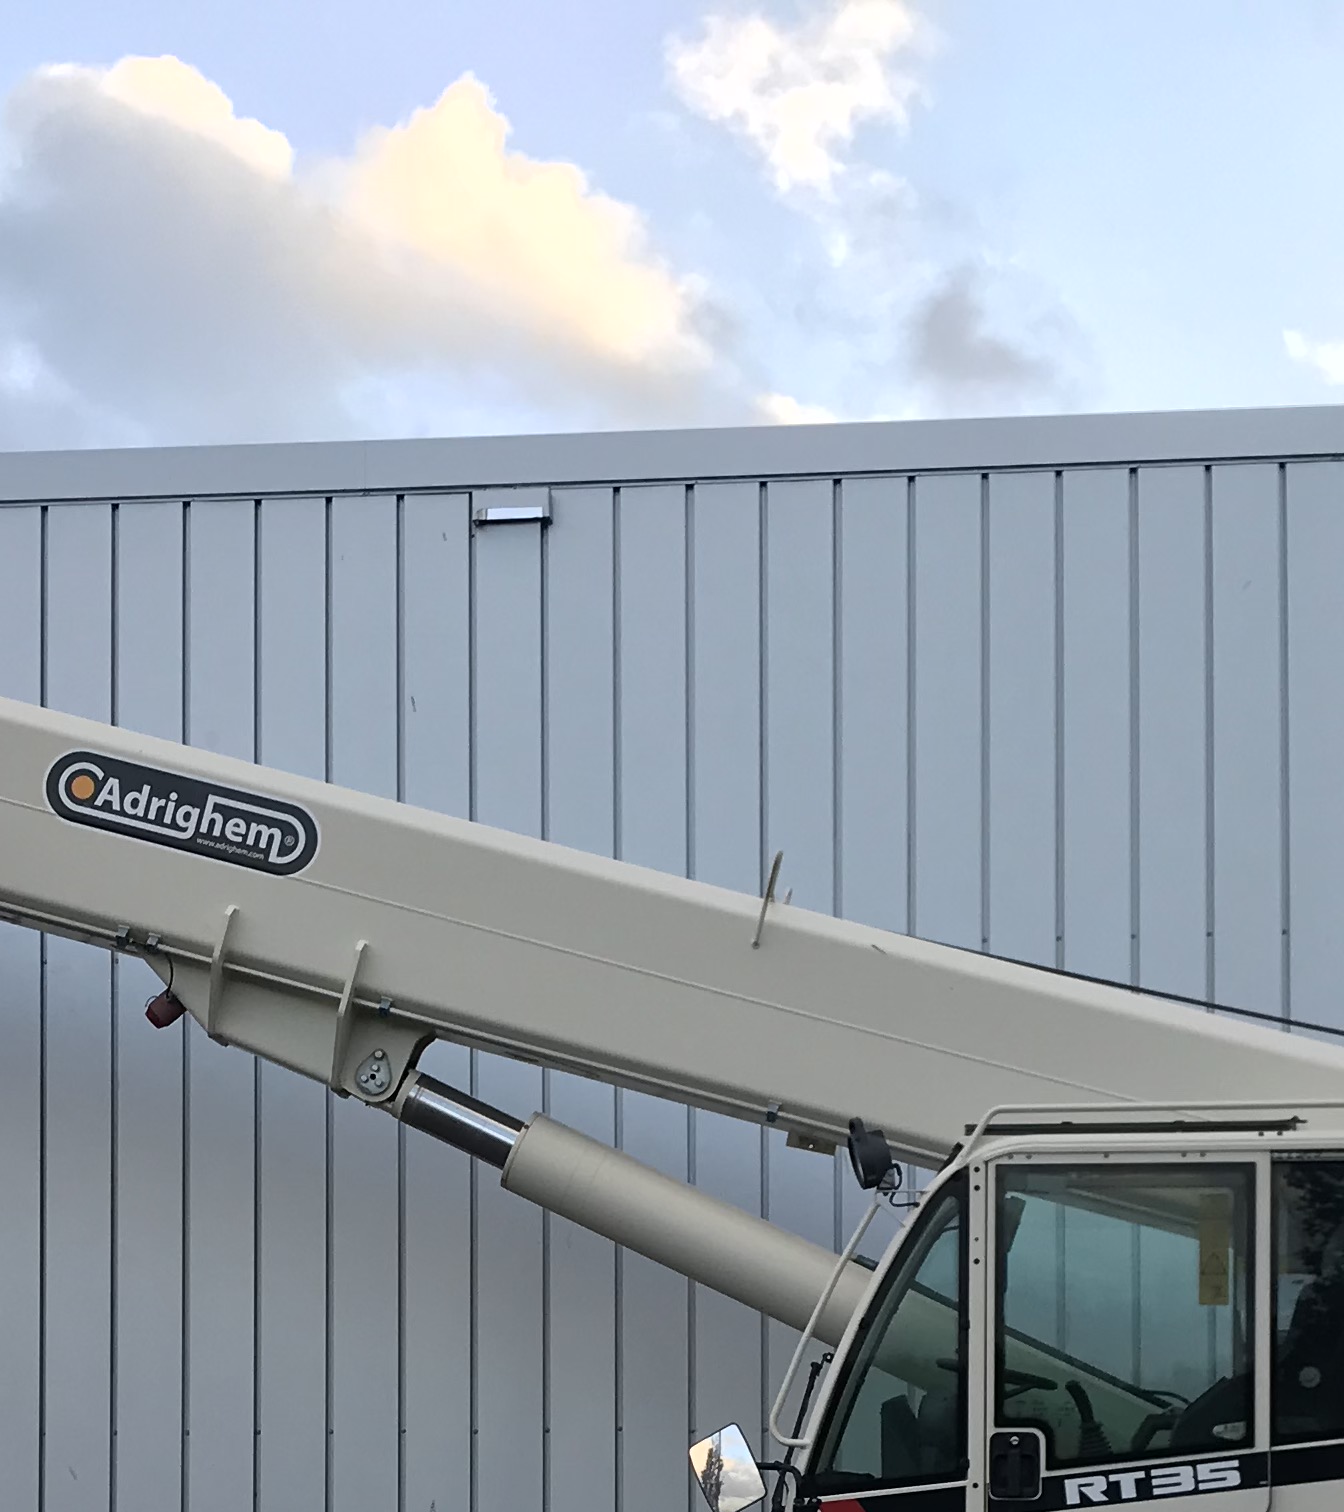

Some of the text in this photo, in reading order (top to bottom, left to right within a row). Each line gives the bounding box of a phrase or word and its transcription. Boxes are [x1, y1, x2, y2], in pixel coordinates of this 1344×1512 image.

[94, 777, 282, 863] Adrighem
[196, 837, 265, 861] www.adrighem.com
[1064, 1459, 1242, 1505] RT35
